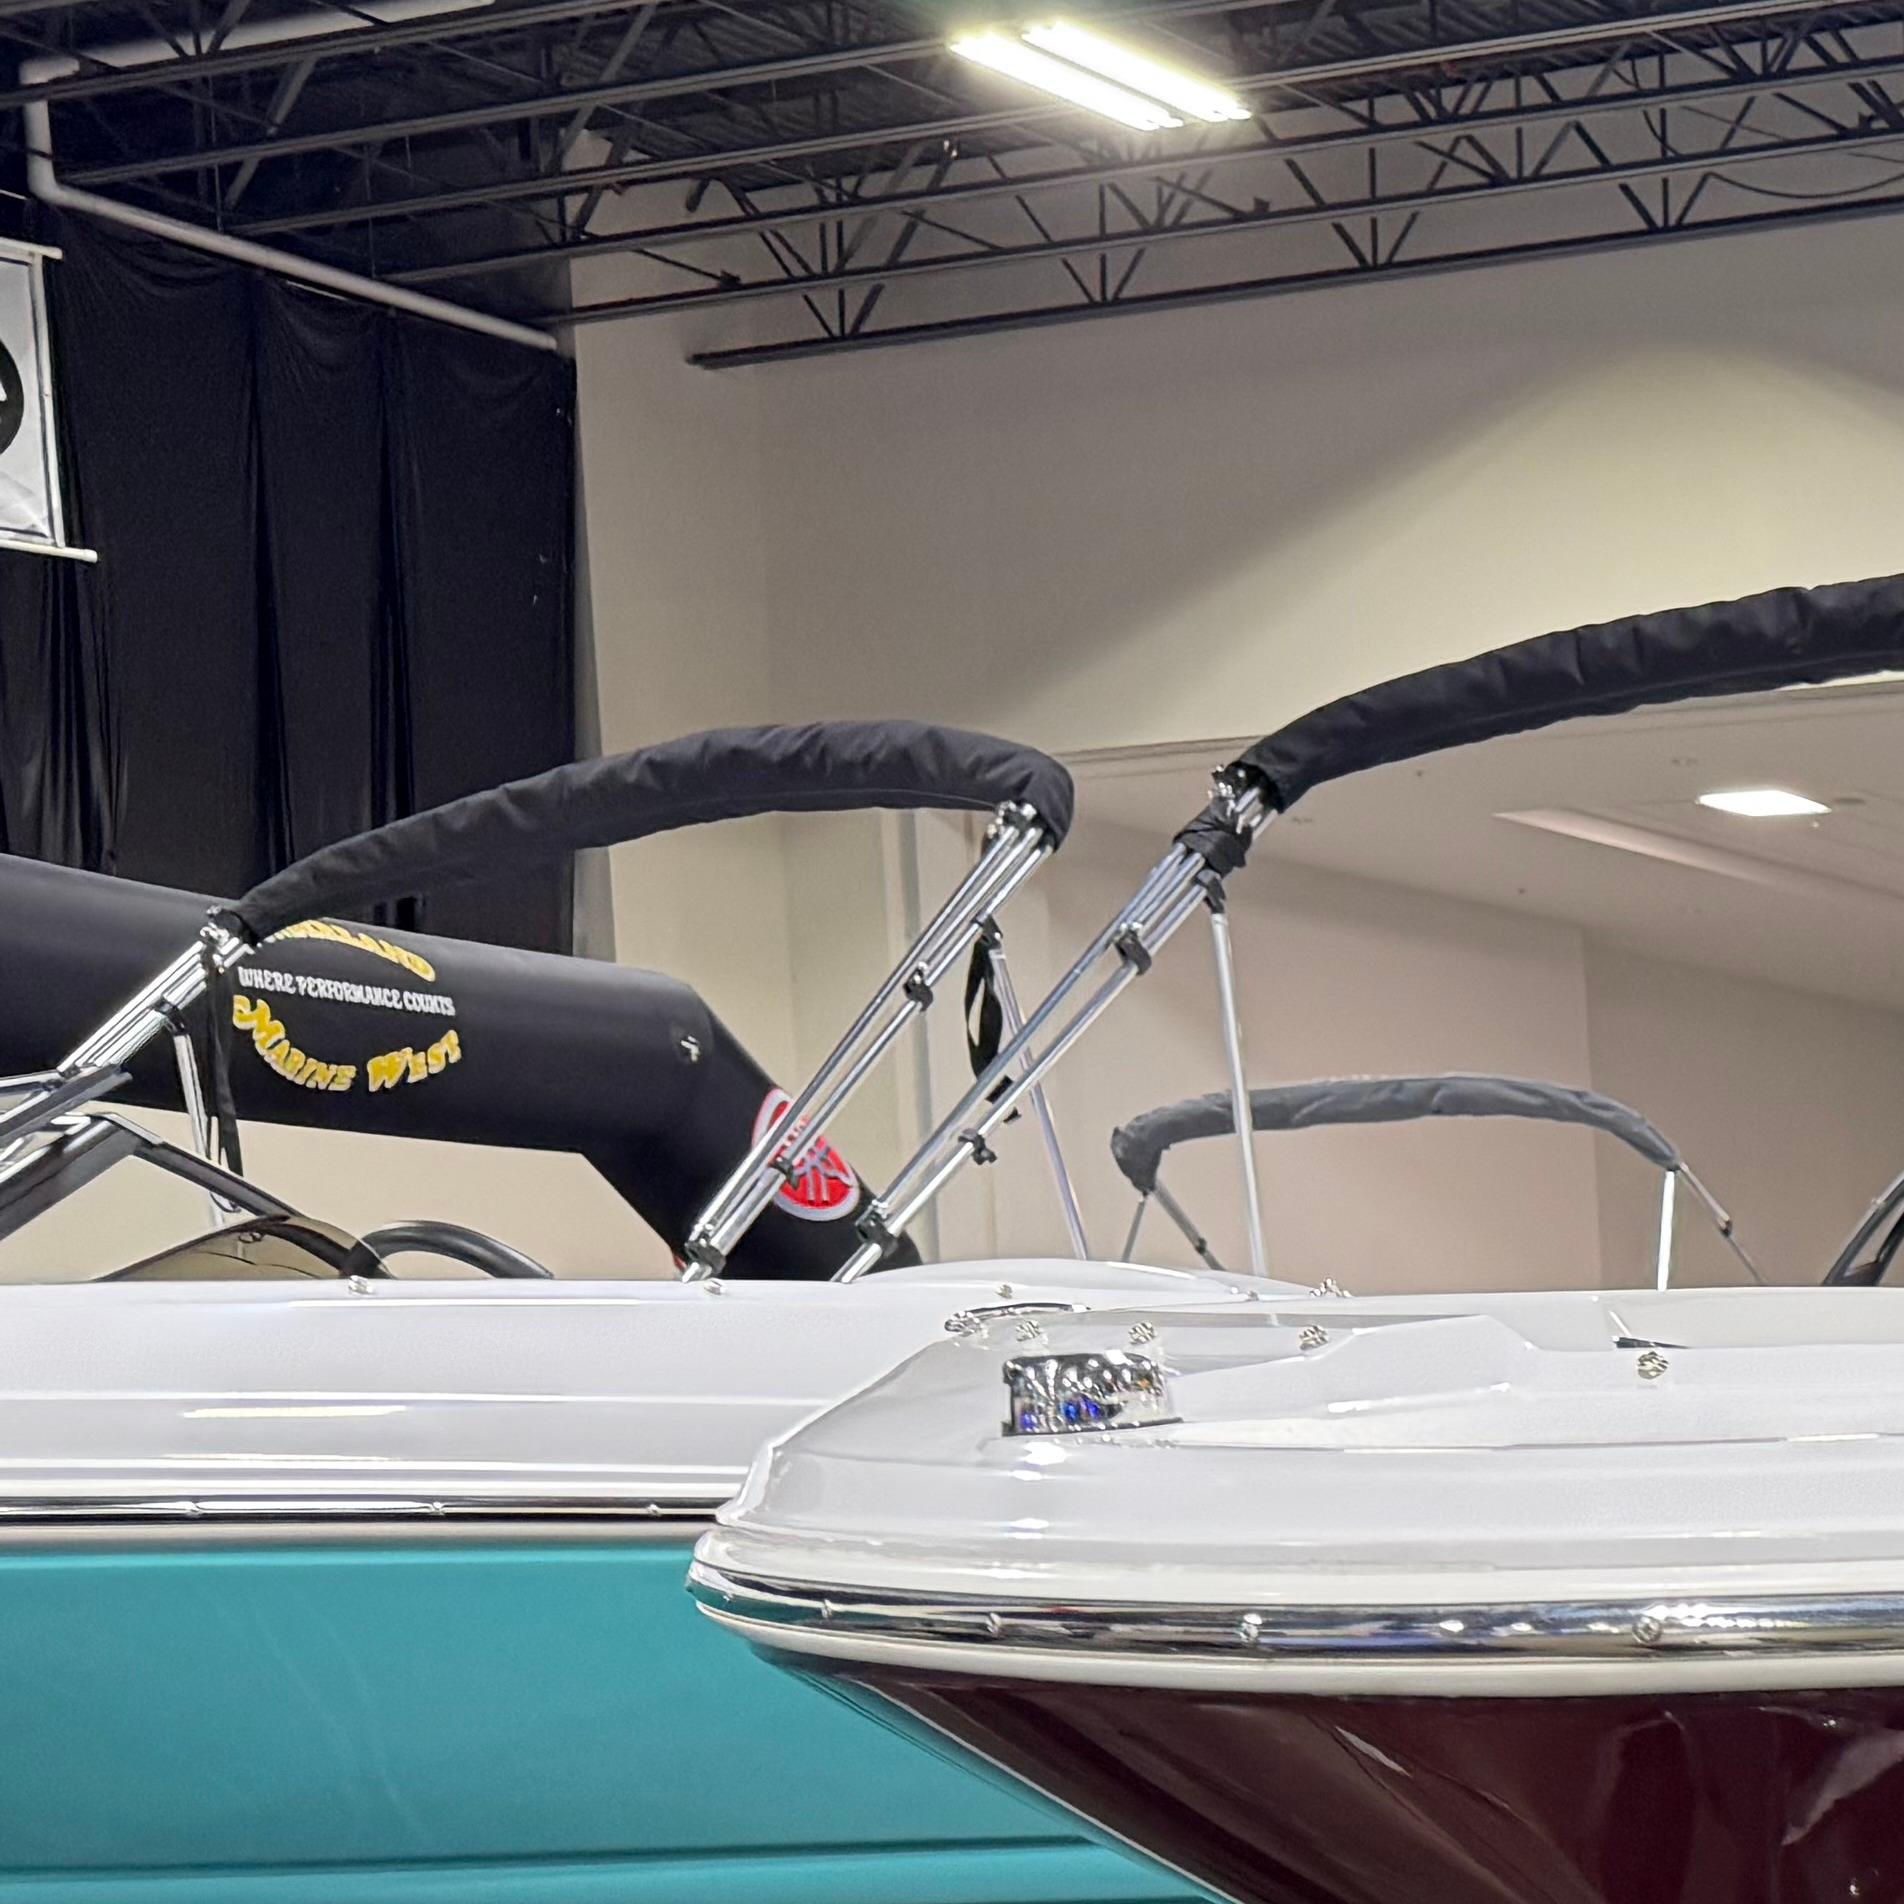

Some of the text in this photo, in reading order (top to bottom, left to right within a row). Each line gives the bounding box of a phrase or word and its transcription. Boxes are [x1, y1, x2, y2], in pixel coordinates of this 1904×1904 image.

[238, 966, 456, 1017] WHERE PERFORMANCE COUNTS
[232, 994, 462, 1093] MARINE WEST
